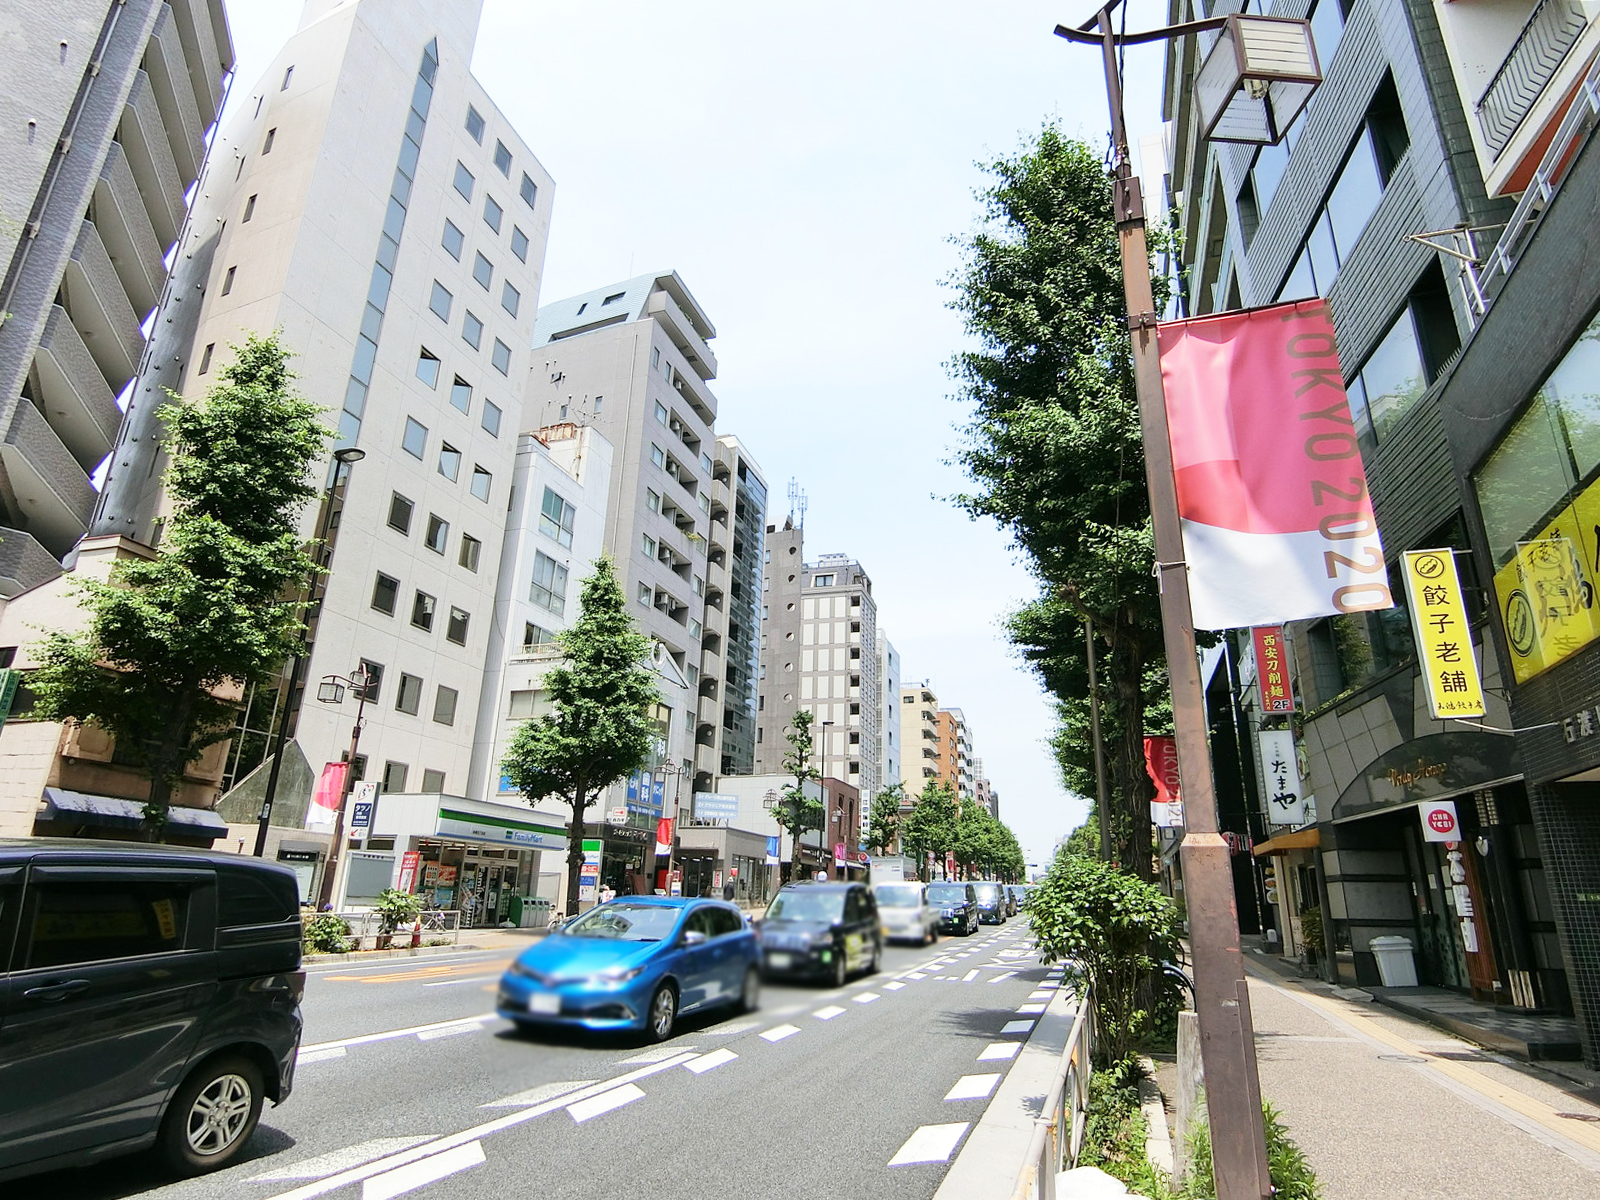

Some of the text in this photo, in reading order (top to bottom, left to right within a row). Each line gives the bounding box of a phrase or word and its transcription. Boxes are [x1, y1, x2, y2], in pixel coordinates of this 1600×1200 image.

[1281, 299, 1391, 613] TOKYO 2020
[1422, 585, 1468, 694] 餃子老舗
[1273, 699, 1289, 710] 2F
[1271, 760, 1297, 810] たまや
[514, 831, 543, 843] FamilyMart
